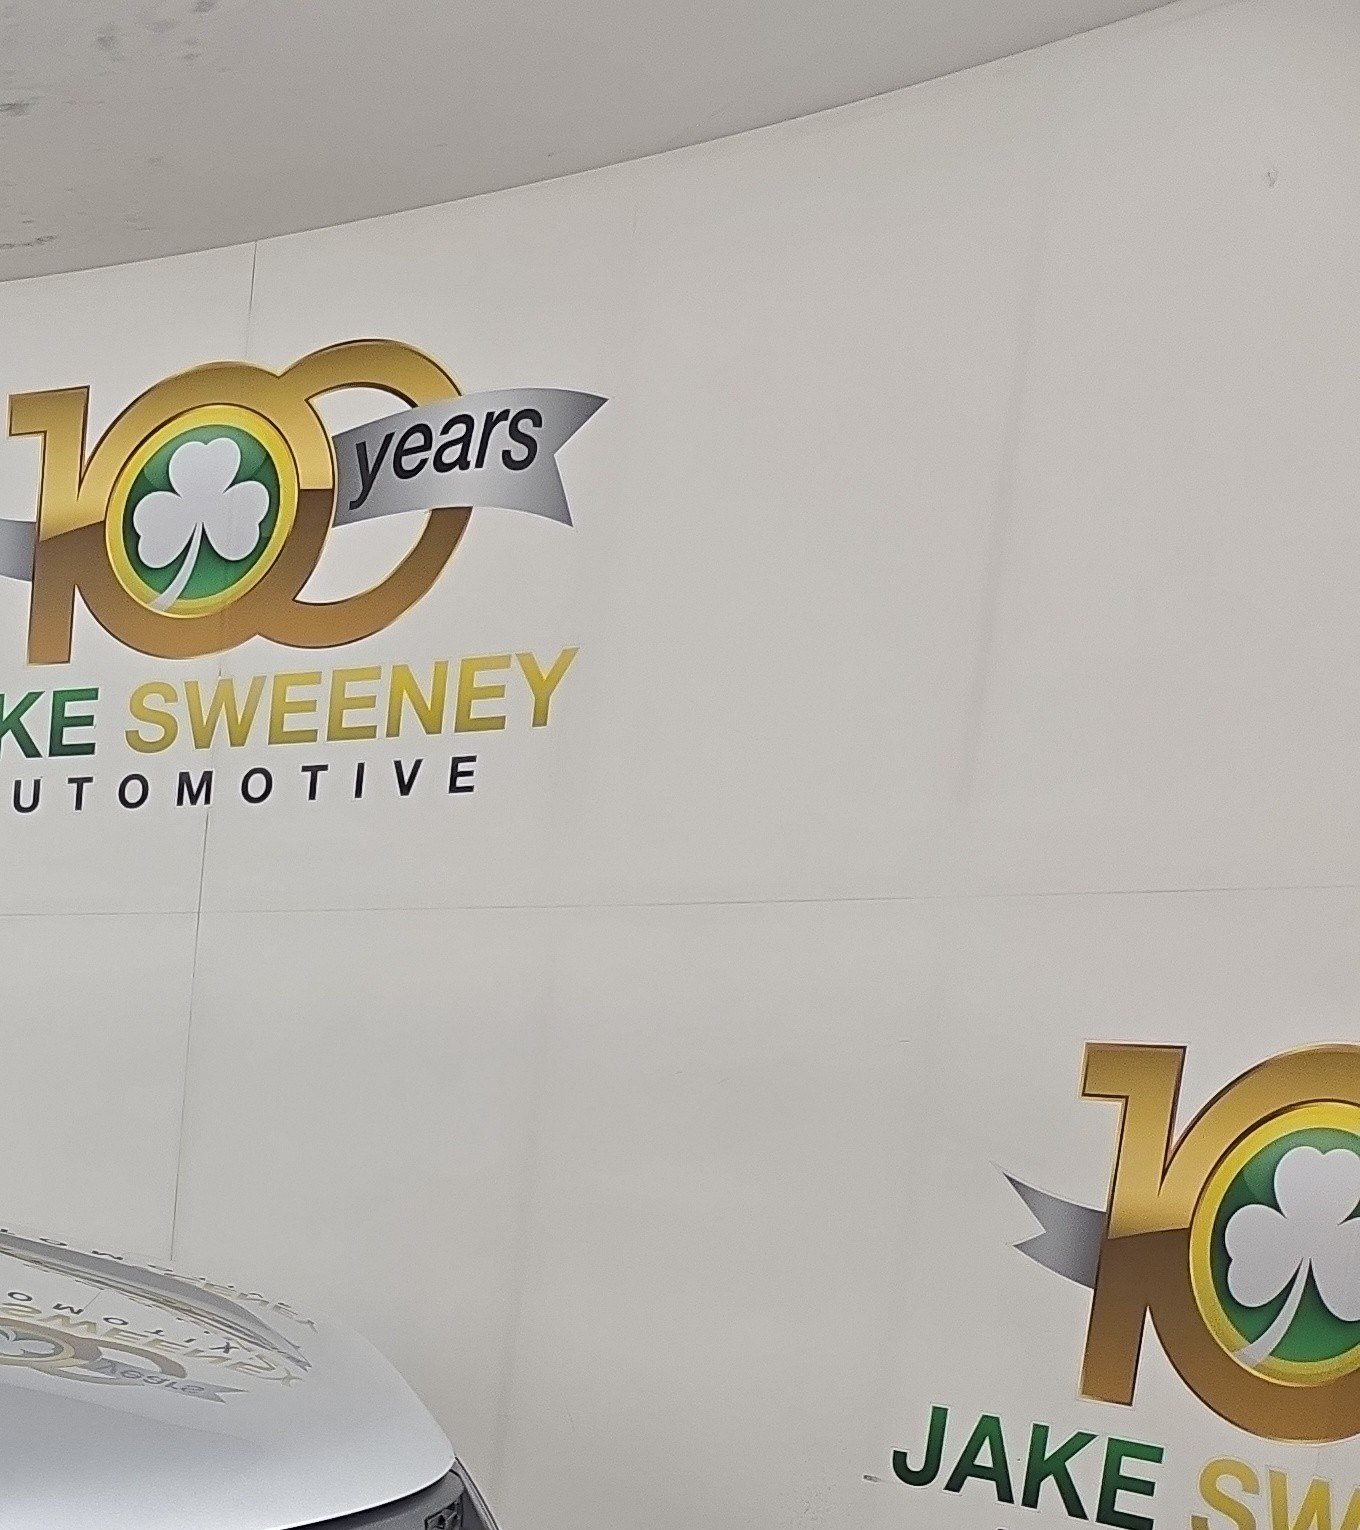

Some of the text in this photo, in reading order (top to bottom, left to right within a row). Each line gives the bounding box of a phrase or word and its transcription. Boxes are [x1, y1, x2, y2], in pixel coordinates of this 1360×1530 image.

[8, 338, 474, 666] 100
[347, 405, 544, 512] years
[124, 646, 580, 755] SWEENEY
